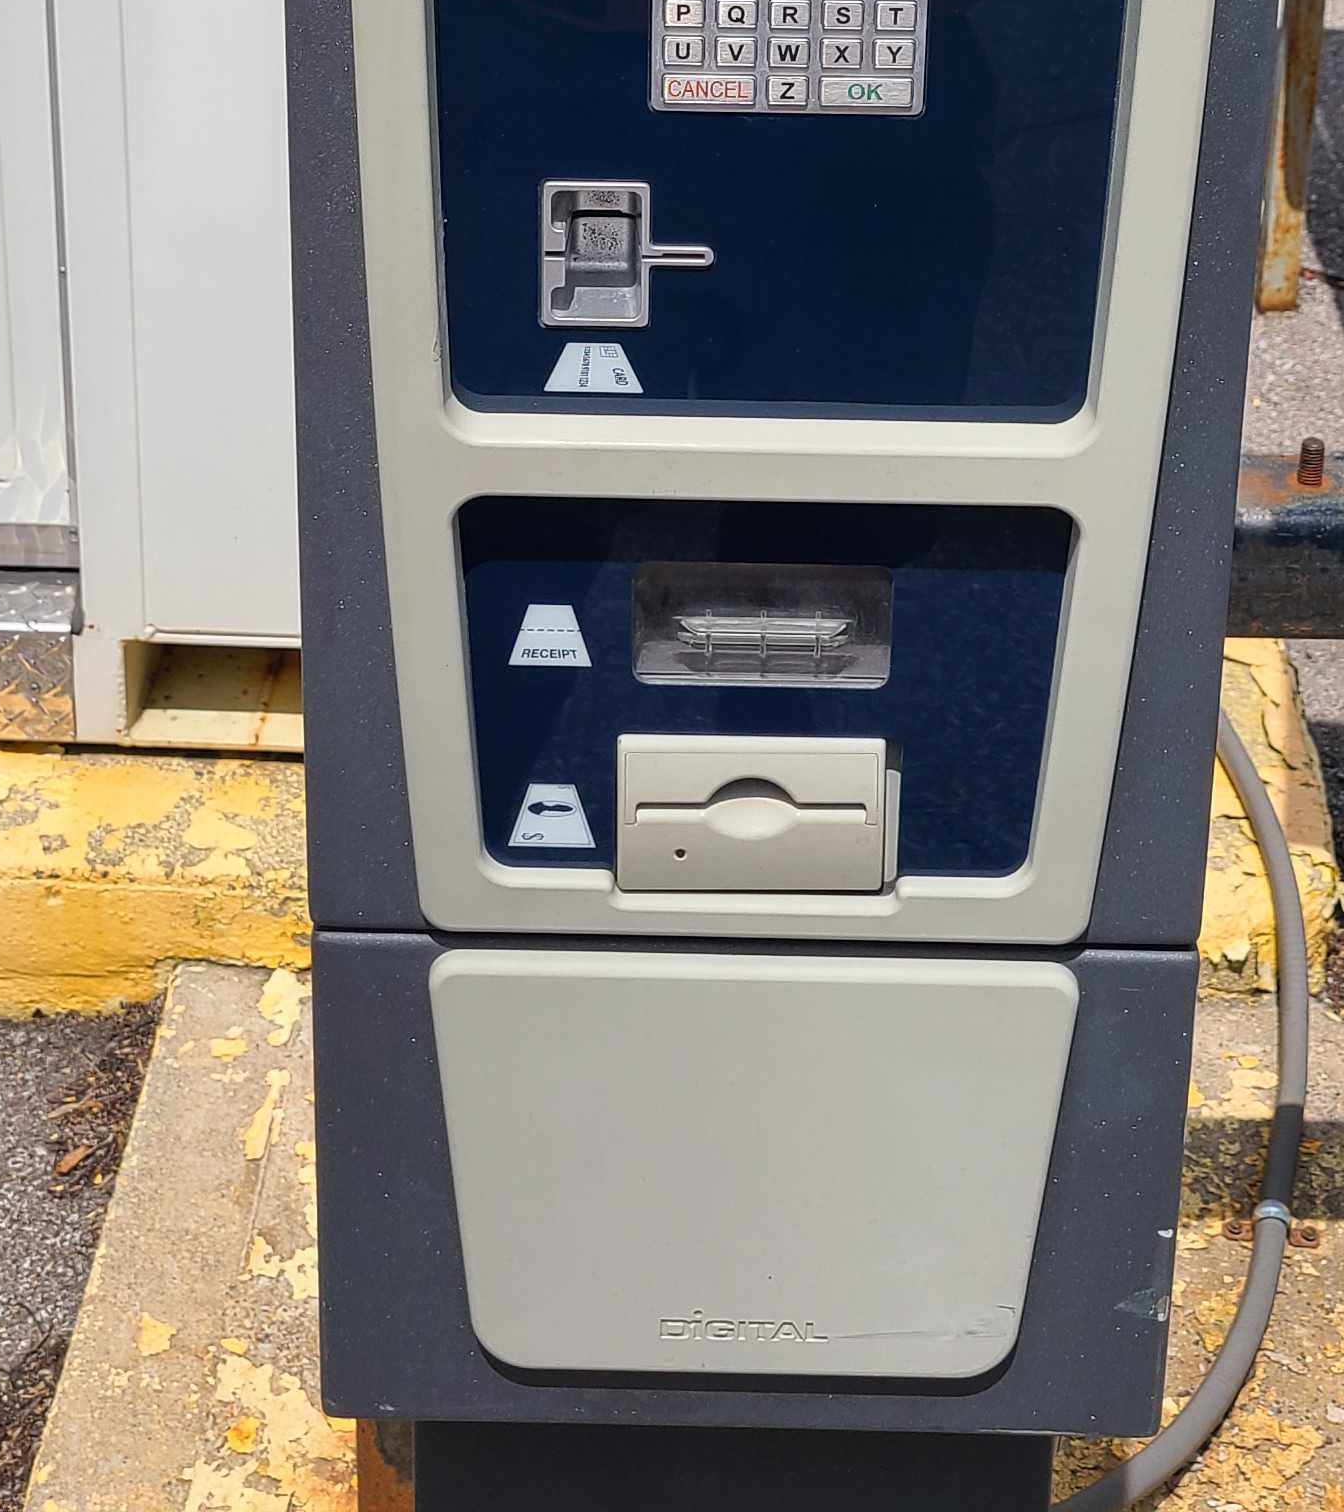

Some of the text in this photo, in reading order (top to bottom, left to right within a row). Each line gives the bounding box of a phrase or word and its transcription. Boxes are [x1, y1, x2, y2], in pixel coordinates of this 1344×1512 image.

[676, 4, 904, 26] P Q R S T
[675, 42, 903, 64] U V W X Y
[667, 79, 883, 101] CANCEL Z OK
[612, 367, 629, 386] CARD
[521, 648, 577, 659] RECEIPT
